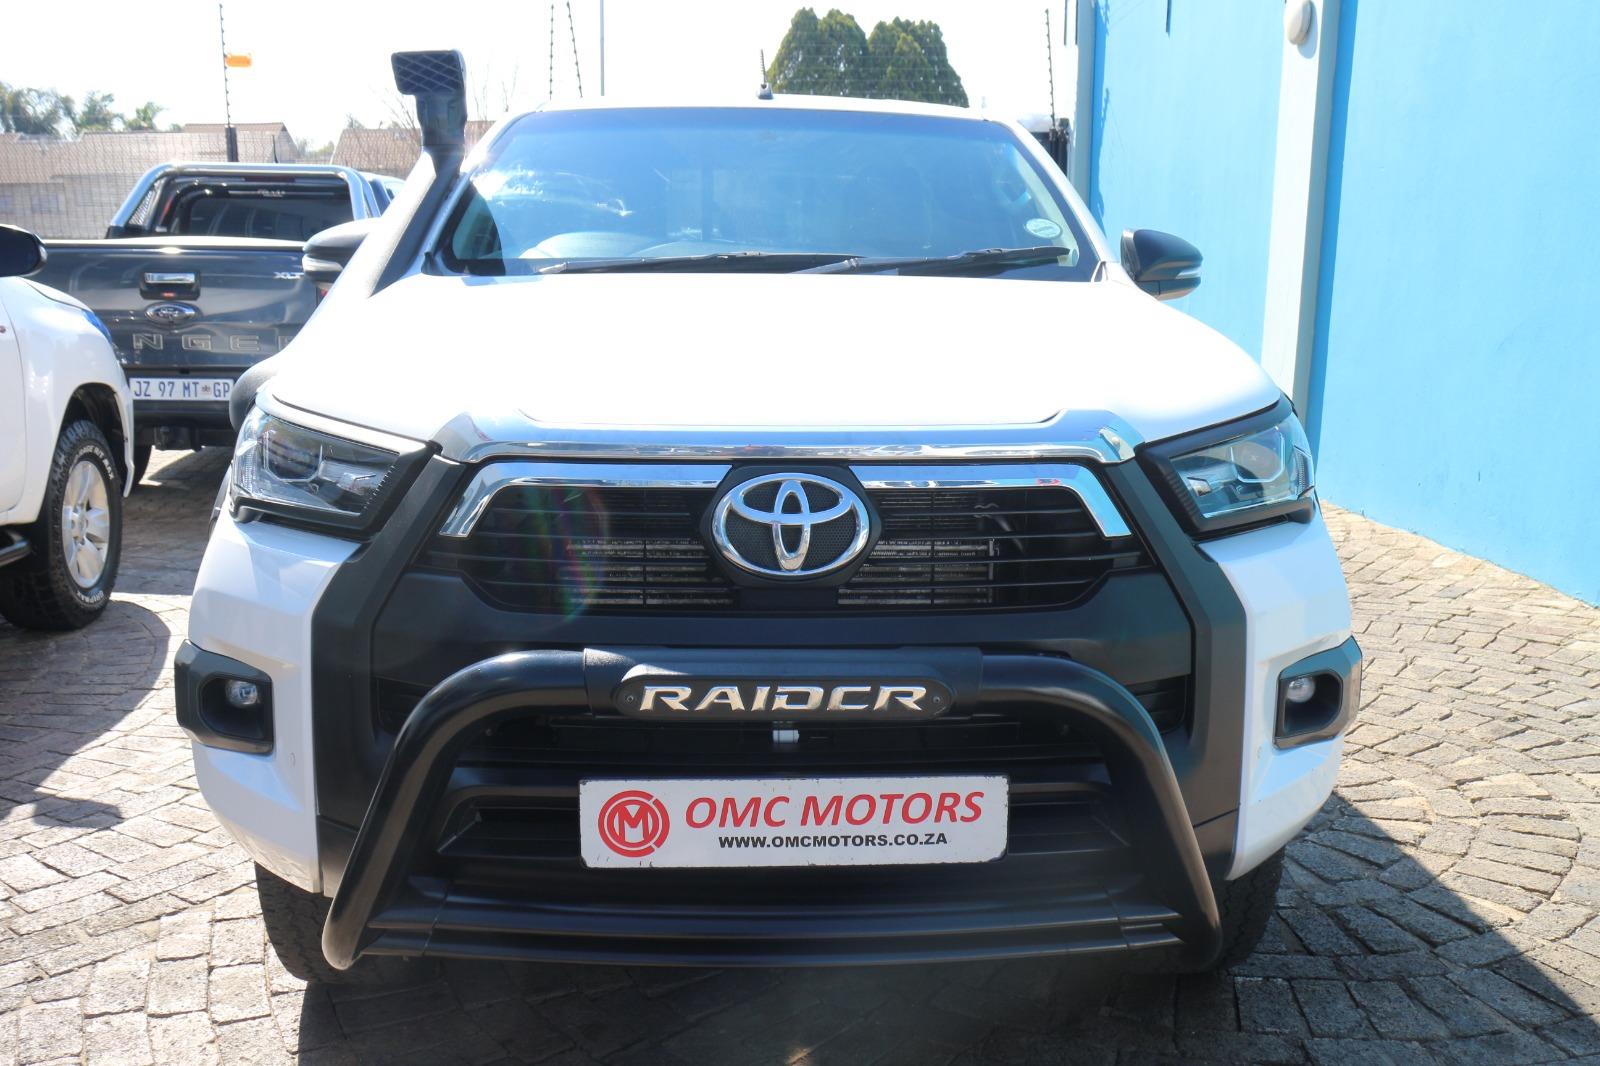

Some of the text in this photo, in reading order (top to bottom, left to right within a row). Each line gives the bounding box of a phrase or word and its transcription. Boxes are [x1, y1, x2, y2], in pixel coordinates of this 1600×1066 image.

[134, 381, 230, 398] JZ 97 MT GP
[686, 791, 985, 829] OMC MOTORS
[719, 833, 948, 848] WWW.OMCMOTORS.CO.ZA
